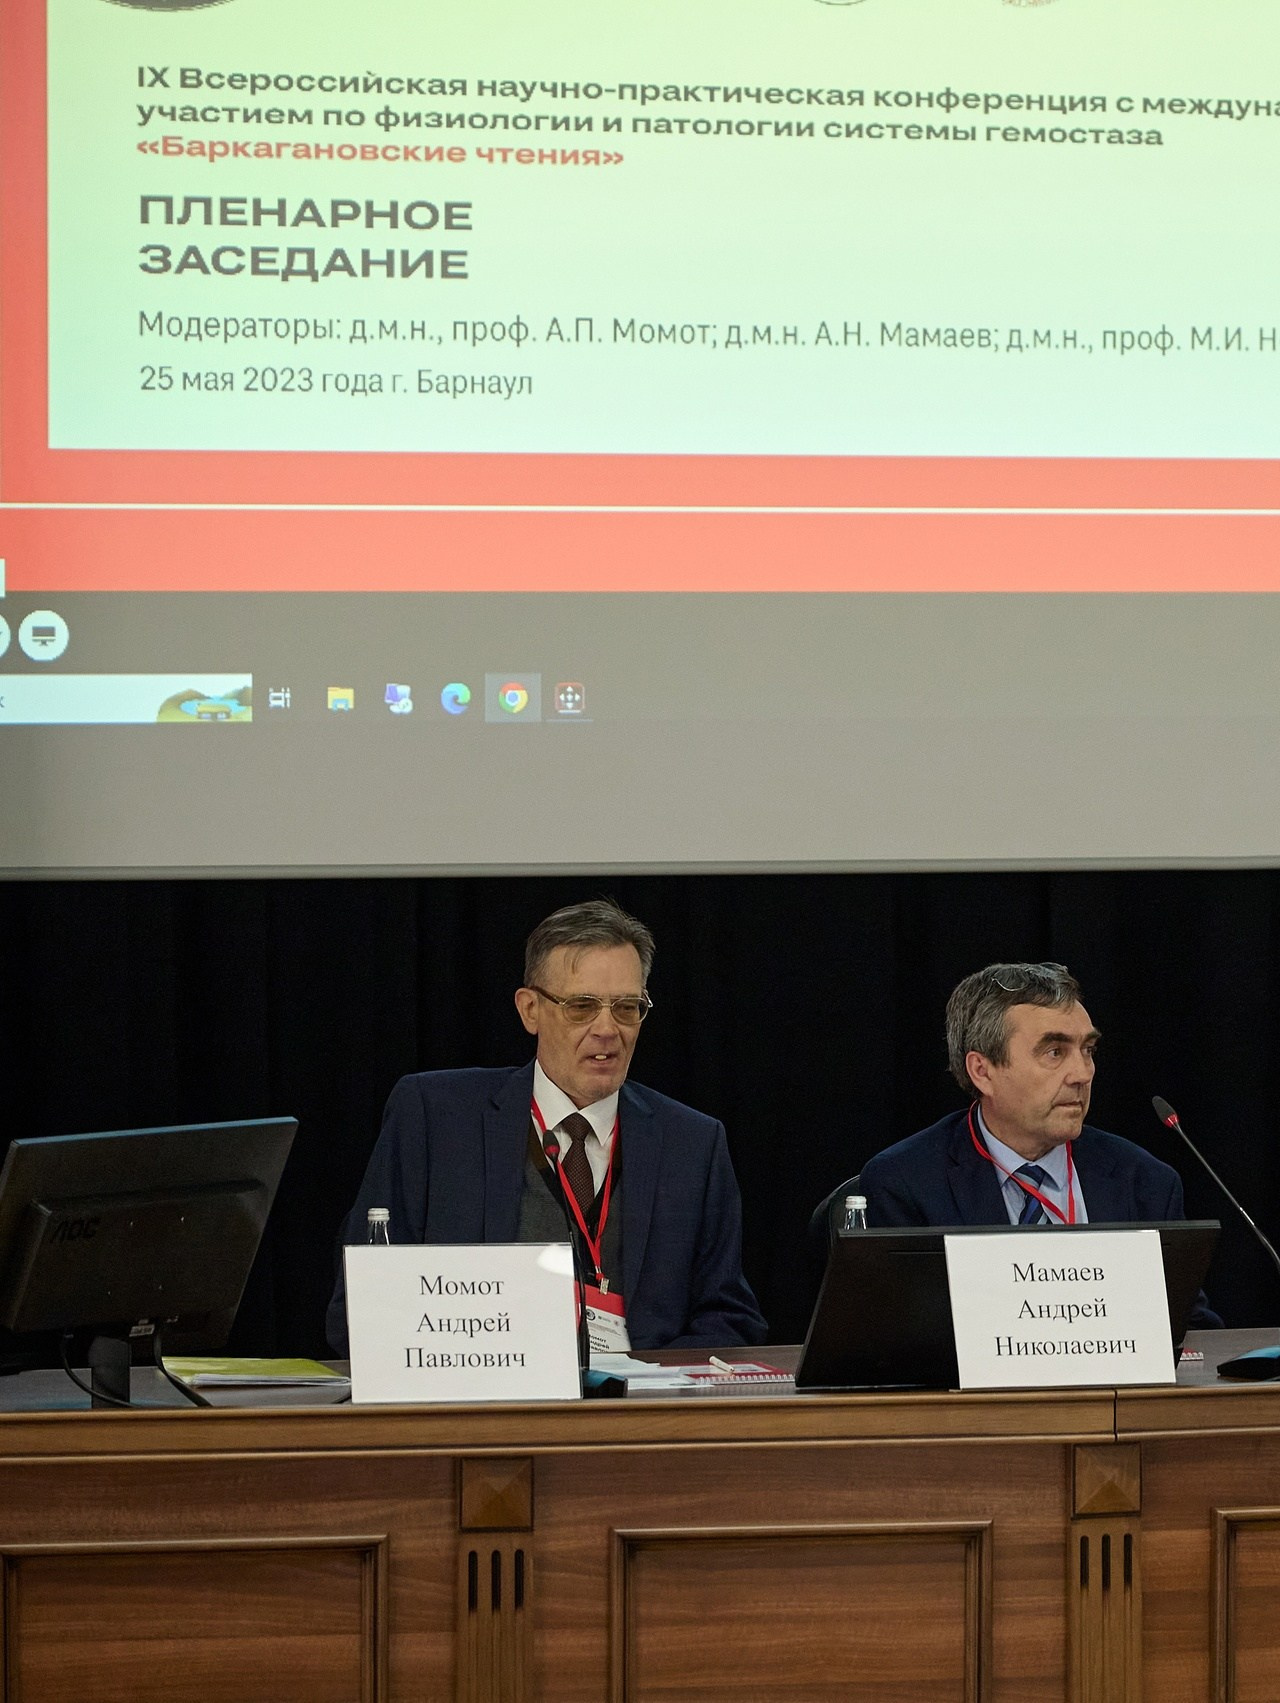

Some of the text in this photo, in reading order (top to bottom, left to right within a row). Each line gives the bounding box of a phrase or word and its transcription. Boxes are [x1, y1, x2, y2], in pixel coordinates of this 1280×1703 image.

[138, 66, 169, 88] IX
[180, 68, 467, 96] Всероссийская
[478, 80, 864, 106] научно-практическая
[874, 87, 1106, 115] конференция
[1116, 97, 1134, 112] с
[137, 104, 1163, 145] участием по физиологии и патологии системы гемостаза
[137, 135, 623, 166] «Баркагановские чтения»
[140, 195, 472, 230] ПЛЕНАРНОЕ
[139, 244, 468, 282] ЗАСЕДАНИЕ
[139, 311, 340, 341] Модераторы:
[349, 319, 442, 345] д.м.н.,
[453, 315, 536, 347] проф.
[546, 317, 601, 342] А.П.
[614, 318, 716, 348] Момот;
[725, 325, 805, 349] д.м.н.
[815, 321, 869, 346] А.Н.
[881, 322, 998, 352] Мамаев;
[1006, 329, 1092, 353] д.м.н.,
[1103, 324, 1180, 356] проф.
[1191, 326, 1248, 351] М.И.
[141, 365, 532, 400] 25 мая 2023 года г. Барнаул
[418, 1275, 504, 1295] Момот
[1011, 1262, 1105, 1283] Мамаев
[416, 1312, 511, 1338] Андрей
[1017, 1297, 1108, 1324] Андрей
[404, 1347, 526, 1368] Павлович
[994, 1336, 1138, 1357] Николаевич
